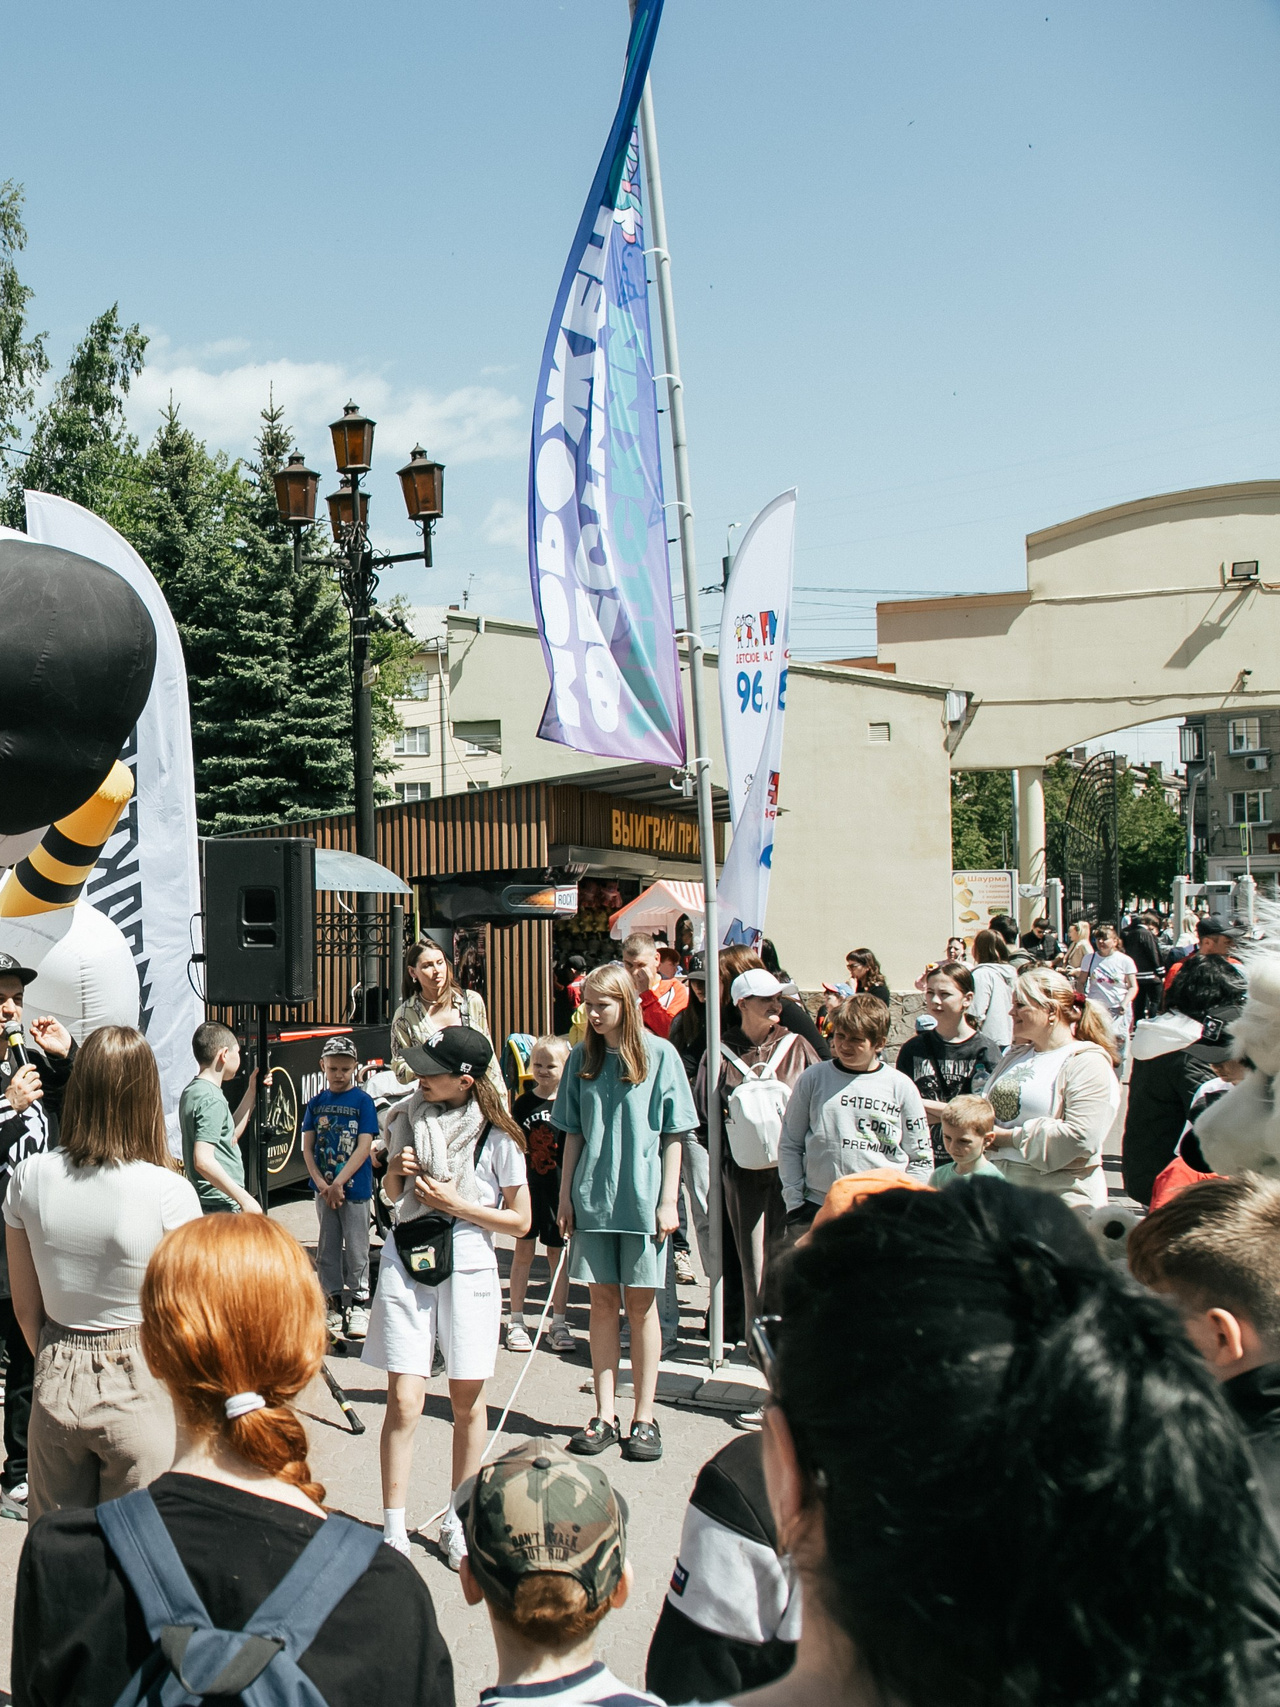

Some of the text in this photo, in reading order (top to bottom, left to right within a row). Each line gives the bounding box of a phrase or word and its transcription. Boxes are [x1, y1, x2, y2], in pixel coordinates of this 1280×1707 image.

[612, 808, 701, 856] ВЫИГРАЙ ПРИ
[967, 875, 1007, 883] Шаурма
[841, 1138, 897, 1157] PREMIUM
